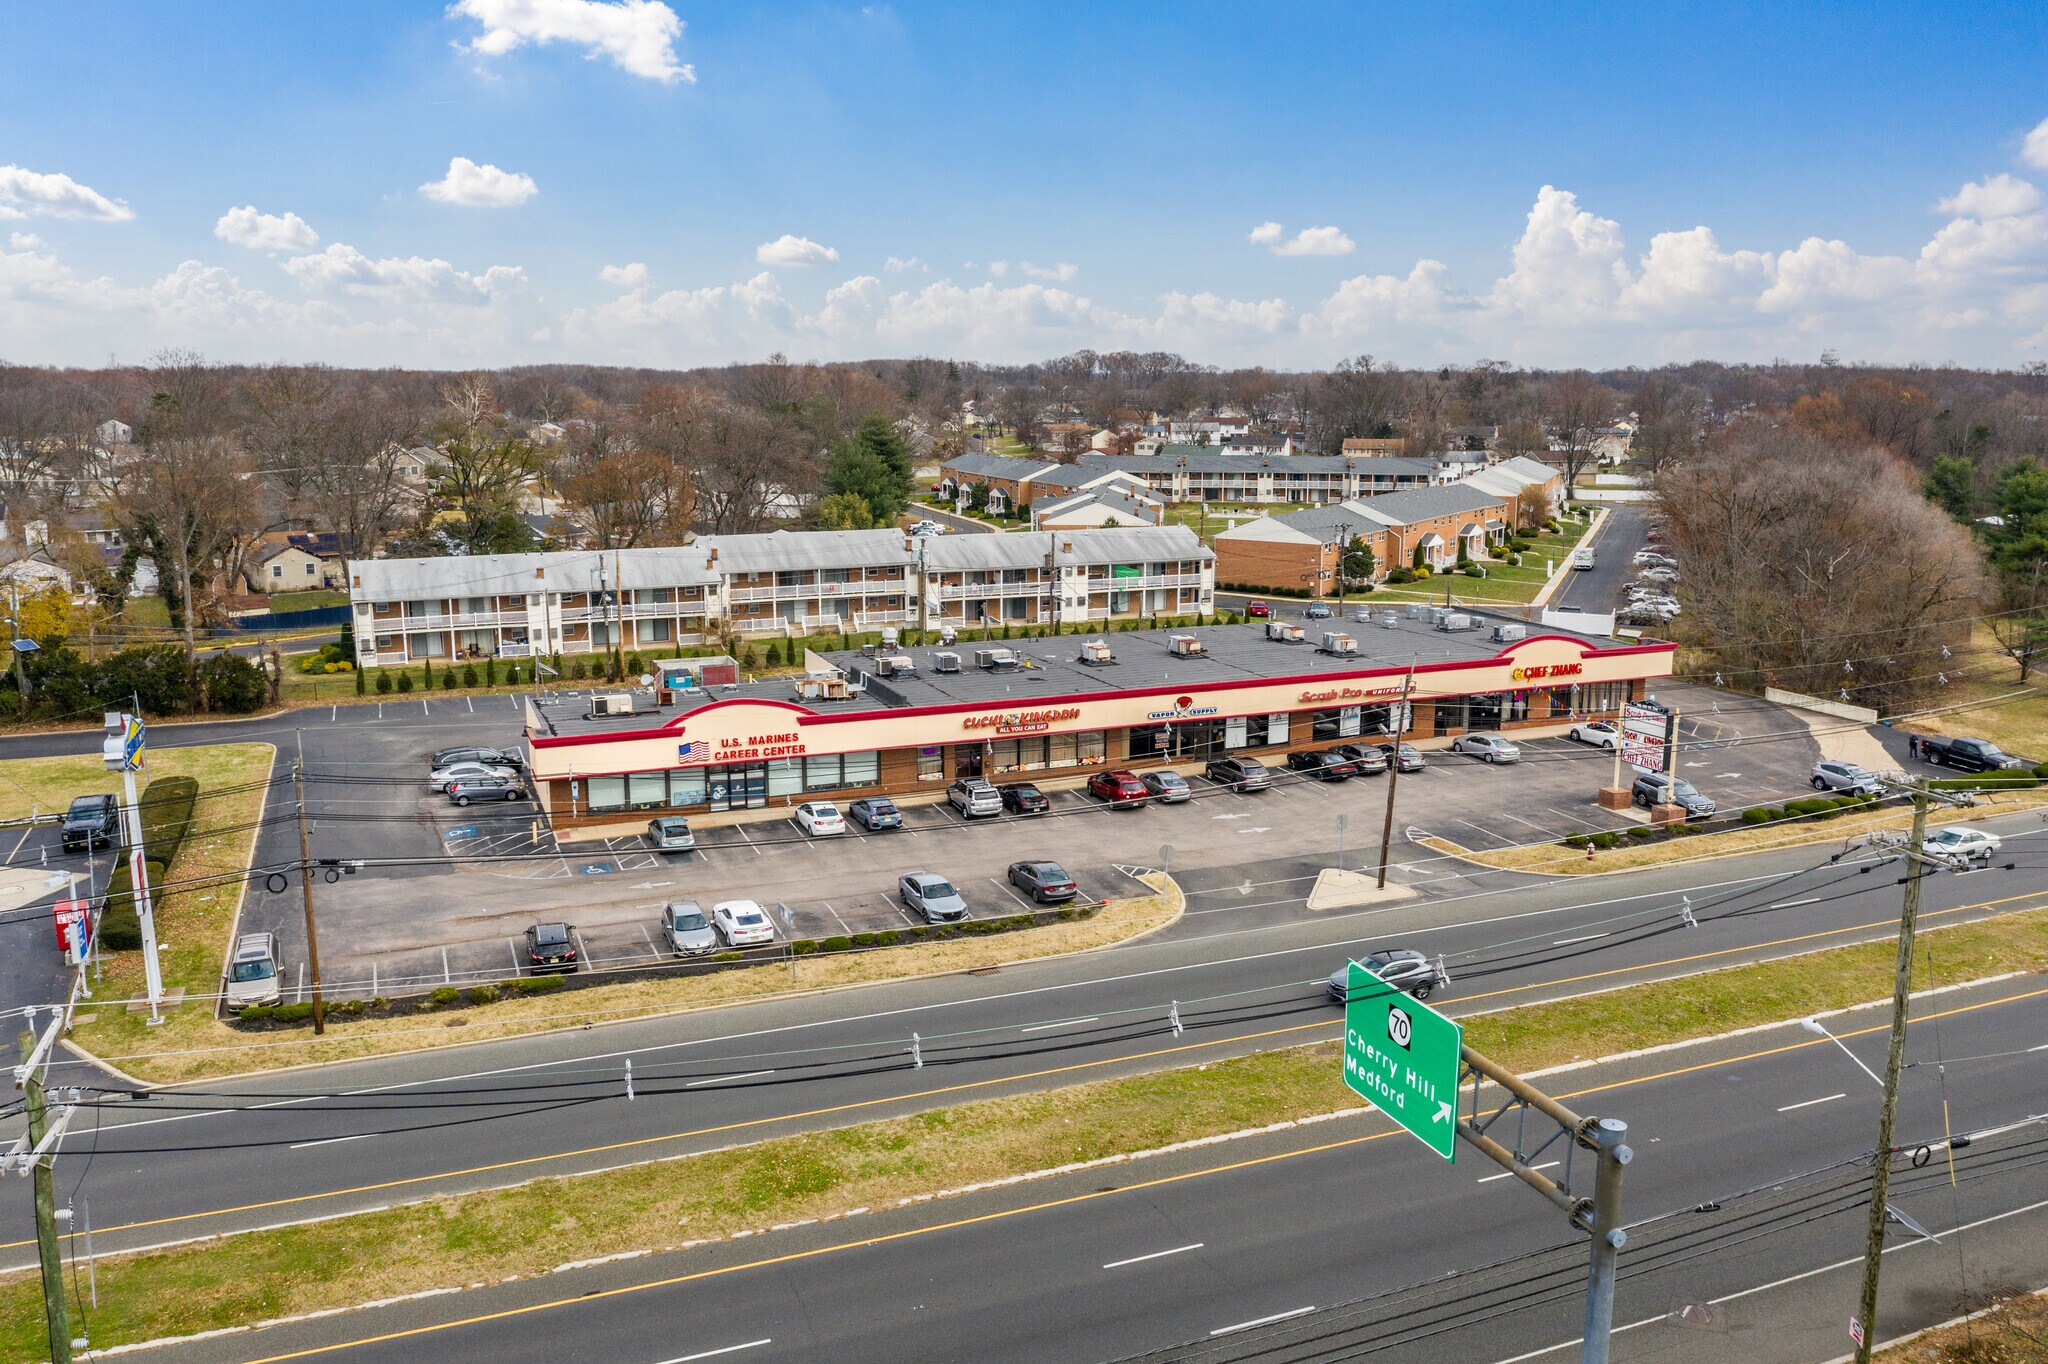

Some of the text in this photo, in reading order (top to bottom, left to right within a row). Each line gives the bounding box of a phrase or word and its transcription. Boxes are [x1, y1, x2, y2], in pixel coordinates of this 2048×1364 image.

[1524, 663, 1582, 682] CHEF ZHANG
[1300, 689, 1338, 702] Scrub
[1341, 688, 1362, 698] Pro
[963, 708, 1080, 729] SUSHI KINGDOM
[1192, 707, 1218, 715] SUPPLY
[721, 732, 799, 748] U.S. MARINES
[715, 744, 806, 761] CAREER CENTER
[1622, 751, 1663, 771] CHEF ZHANG
[1392, 1013, 1408, 1039] 70
[1348, 1028, 1435, 1102] Cherry Hill
[1346, 1053, 1405, 1109] Medford
